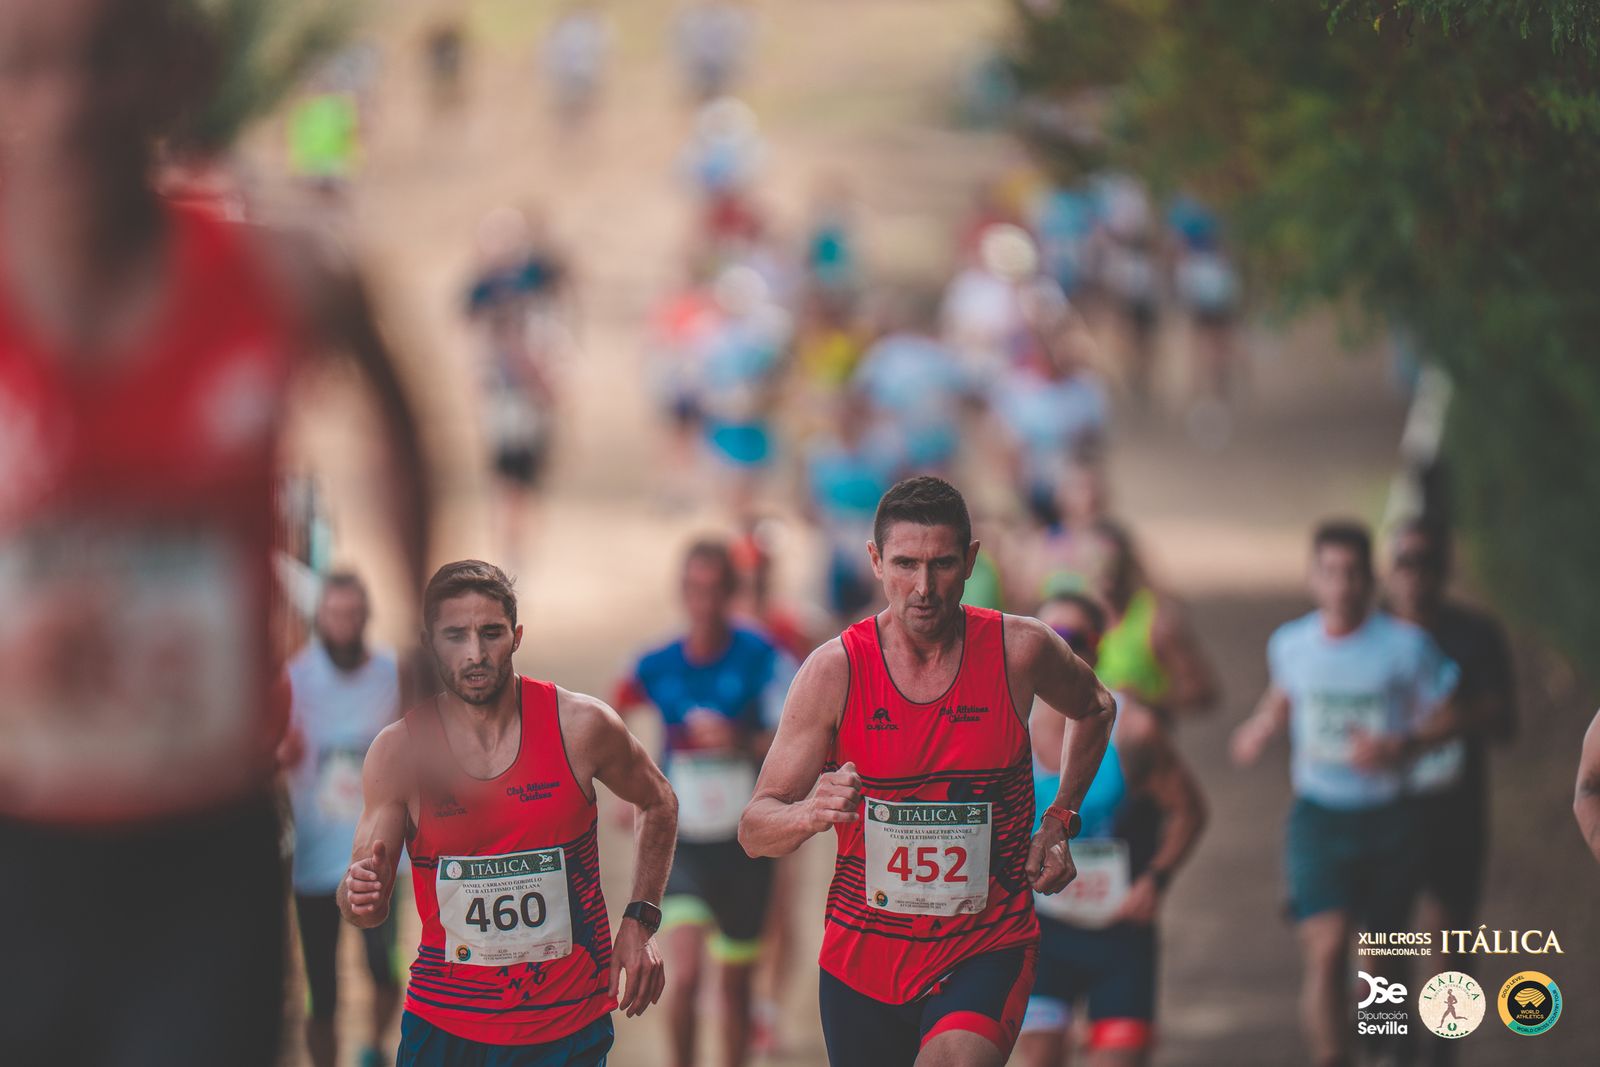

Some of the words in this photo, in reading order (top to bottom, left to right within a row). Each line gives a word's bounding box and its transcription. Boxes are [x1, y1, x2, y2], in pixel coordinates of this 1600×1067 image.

[897, 806, 957, 822] ITÁLICA
[470, 859, 530, 876] ITÁLICA
[887, 846, 969, 883] 452
[465, 891, 547, 932] 460
